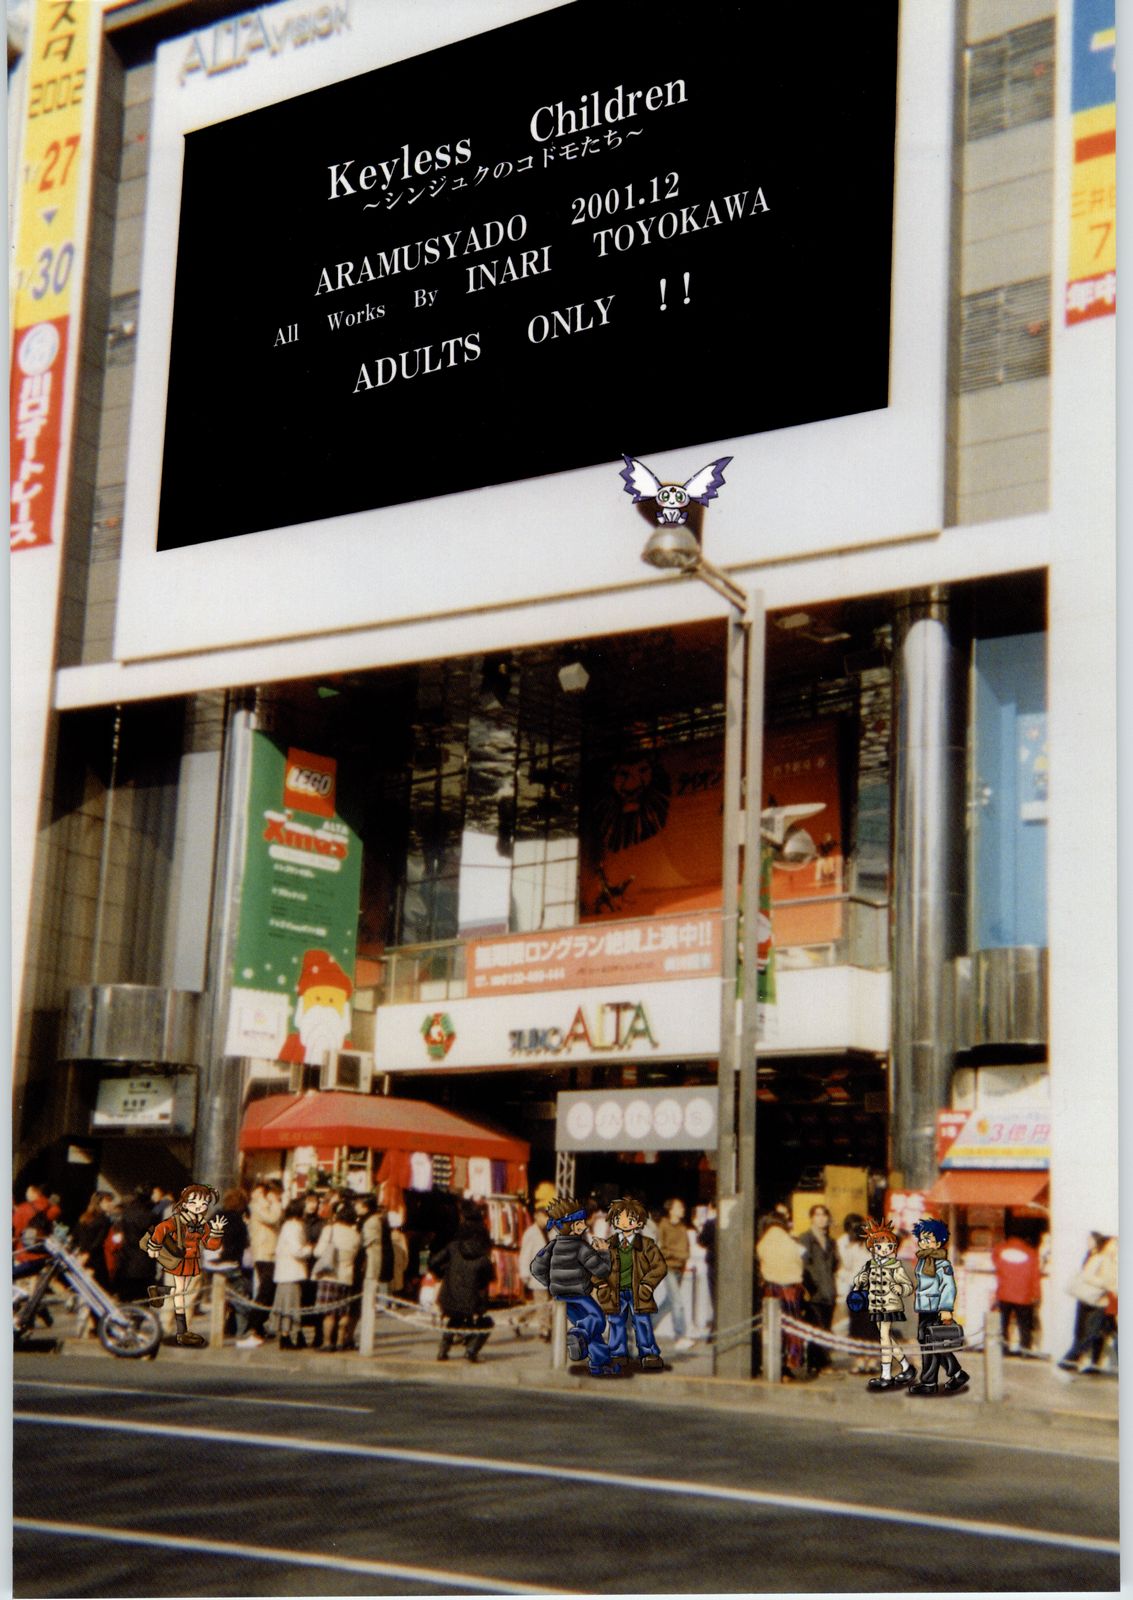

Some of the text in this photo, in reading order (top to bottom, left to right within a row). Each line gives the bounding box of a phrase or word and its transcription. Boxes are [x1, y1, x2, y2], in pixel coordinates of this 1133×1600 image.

[28, 68, 86, 119] 2002
[287, 767, 331, 796] LEGO
[563, 1001, 659, 1052] ALTA
